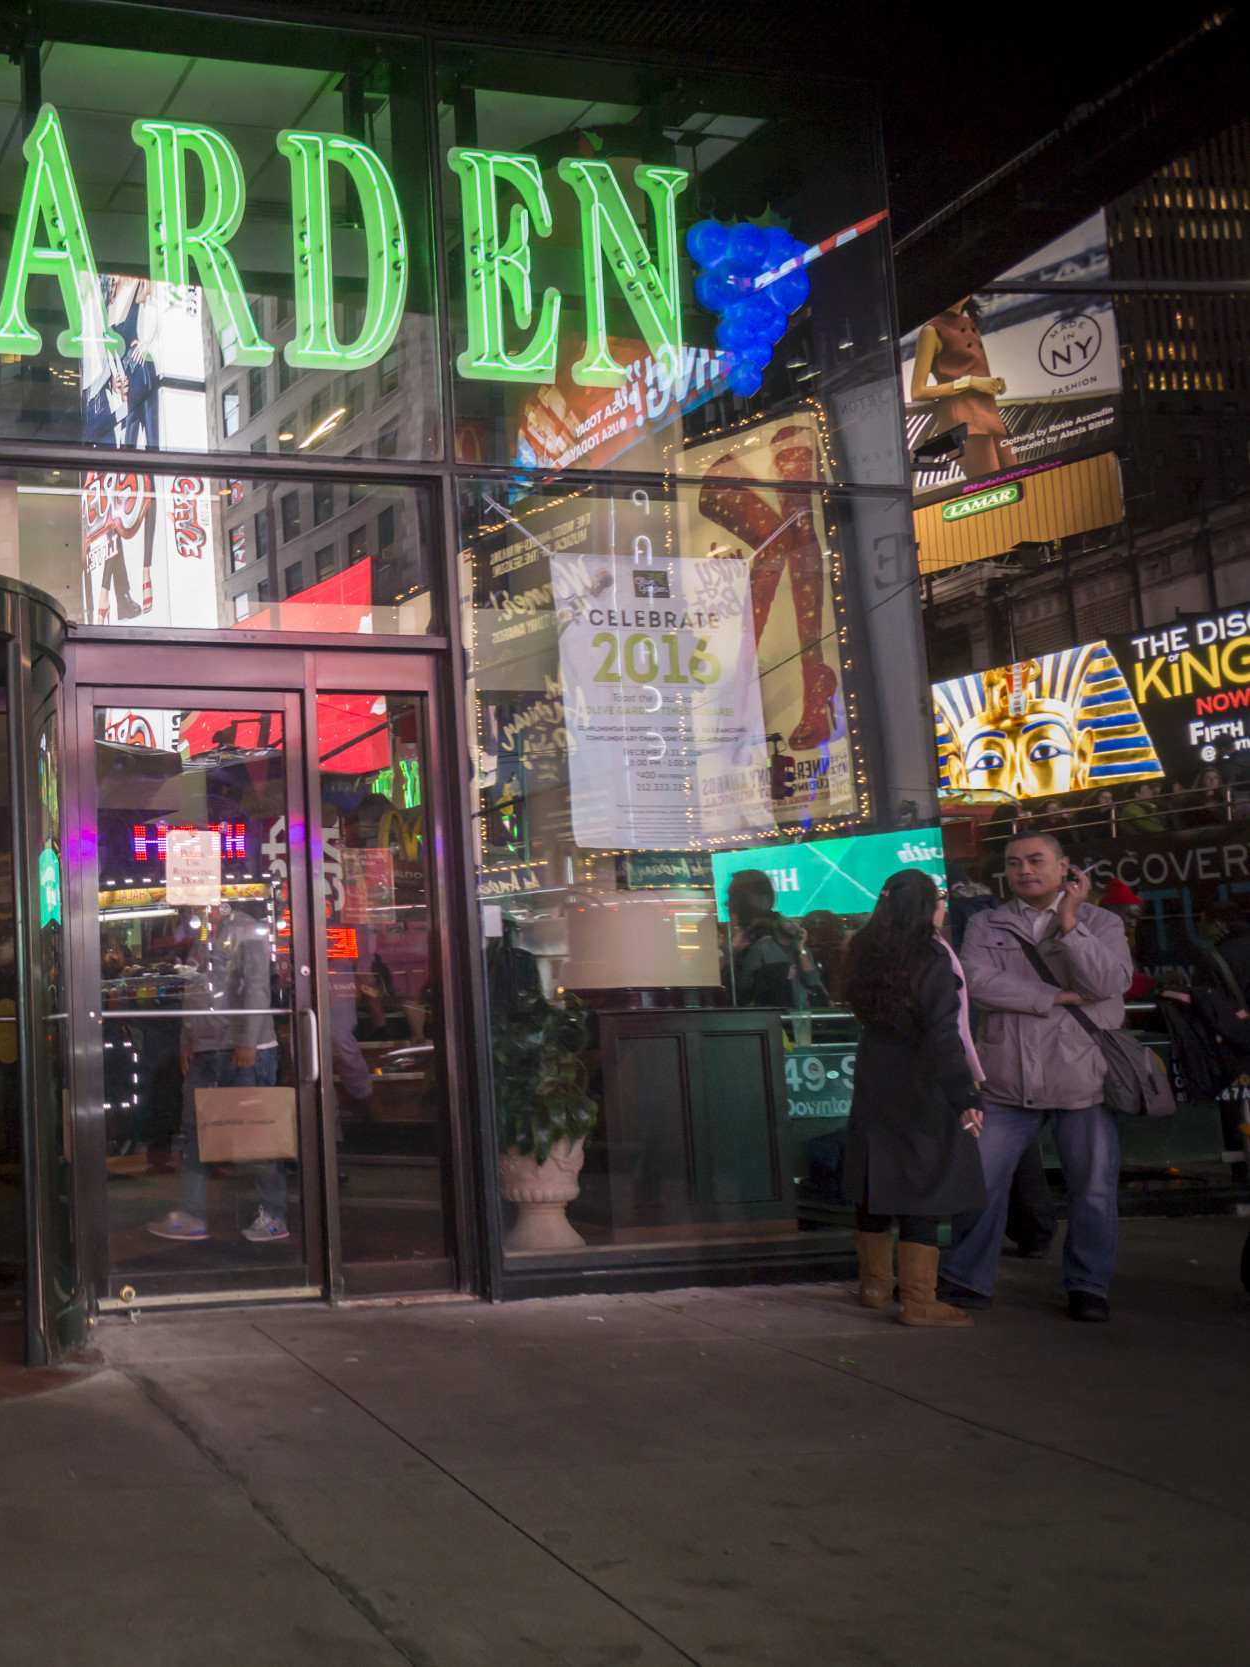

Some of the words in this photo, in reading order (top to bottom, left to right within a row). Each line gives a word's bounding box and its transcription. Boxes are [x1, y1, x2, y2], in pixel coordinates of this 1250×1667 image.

[1050, 320, 1086, 339] MADE
[1063, 331, 1075, 342] IN
[1051, 336, 1094, 370] NY
[1051, 375, 1098, 397] FASHION
[1000, 431, 1035, 448] Clothing
[1036, 428, 1048, 440] by
[1049, 420, 1074, 433] Rosie
[1075, 406, 1114, 425] Assoulin
[1011, 438, 1046, 454] Bracelet
[1047, 435, 1059, 446] by
[1060, 425, 1087, 441] Alexis
[1088, 417, 1115, 433] Bittar
[950, 489, 1012, 518] LAMAR
[635, 576, 655, 585] Olive
[589, 608, 720, 628] CELEBRATE
[1131, 625, 1190, 660] THE
[1196, 610, 1250, 646] DIS
[592, 632, 723, 685] 2016
[1168, 653, 1181, 662] OF
[586, 705, 615, 715] OLIVE
[661, 706, 690, 716] TIMES
[1195, 687, 1250, 716] NOW
[1189, 718, 1245, 746] FIFTH
[173, 867, 214, 876] REVOLVING
[186, 858, 199, 866] USE
[182, 876, 205, 885] DOOR
